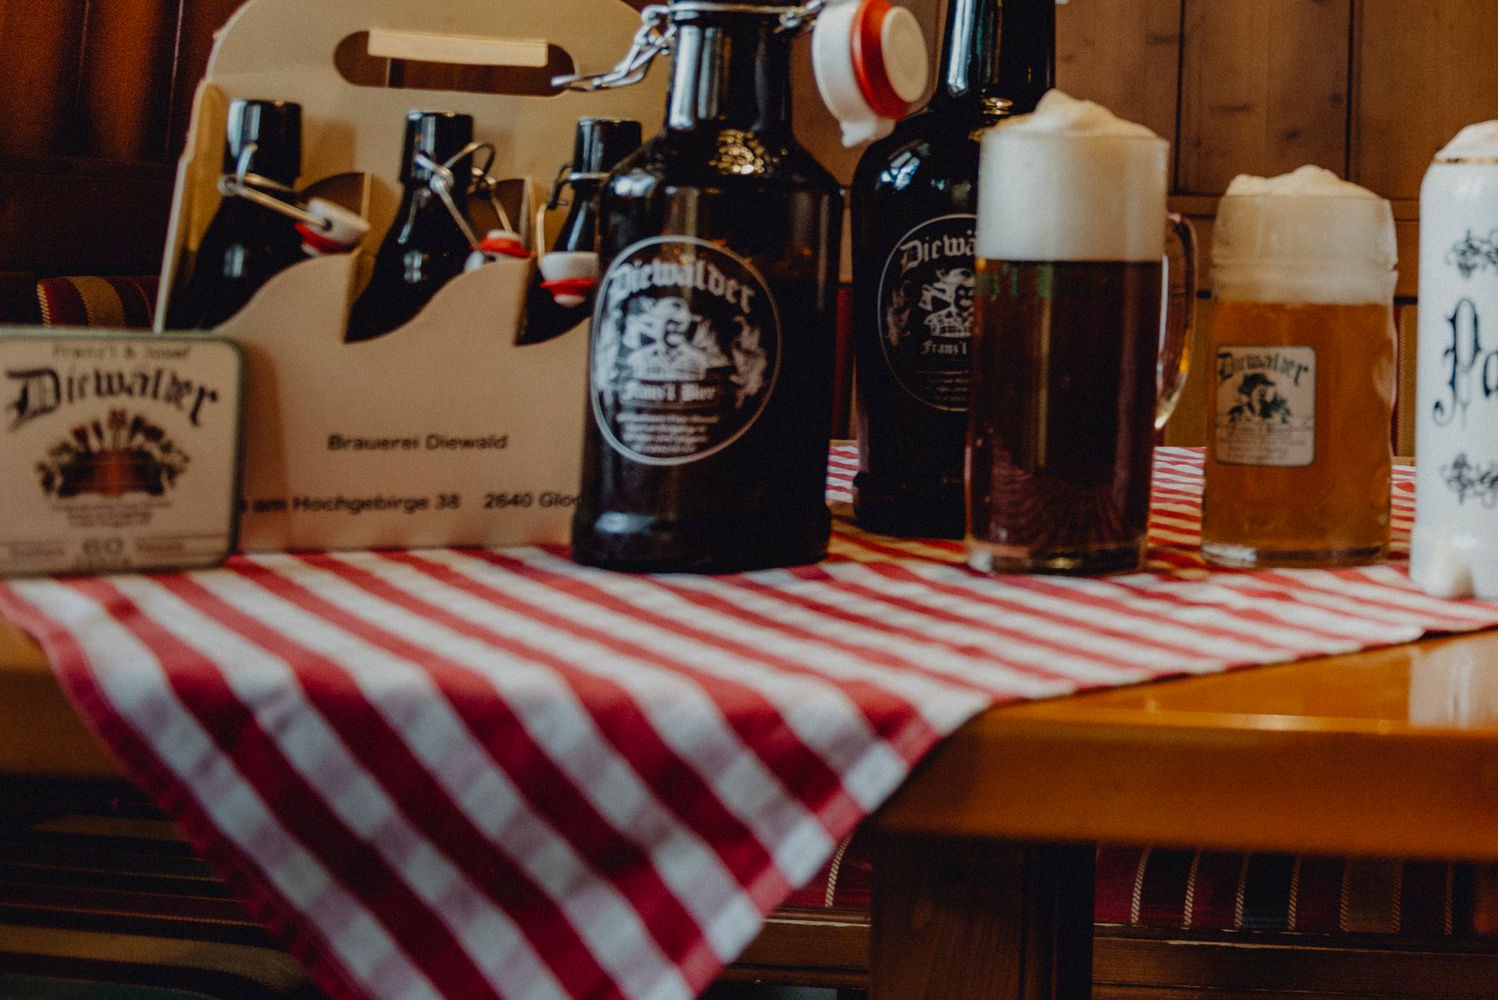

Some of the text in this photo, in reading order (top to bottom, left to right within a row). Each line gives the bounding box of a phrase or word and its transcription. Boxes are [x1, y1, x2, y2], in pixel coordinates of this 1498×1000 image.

[327, 434, 509, 451] Brauerei Diewald
[292, 496, 429, 515] Hochgebirge
